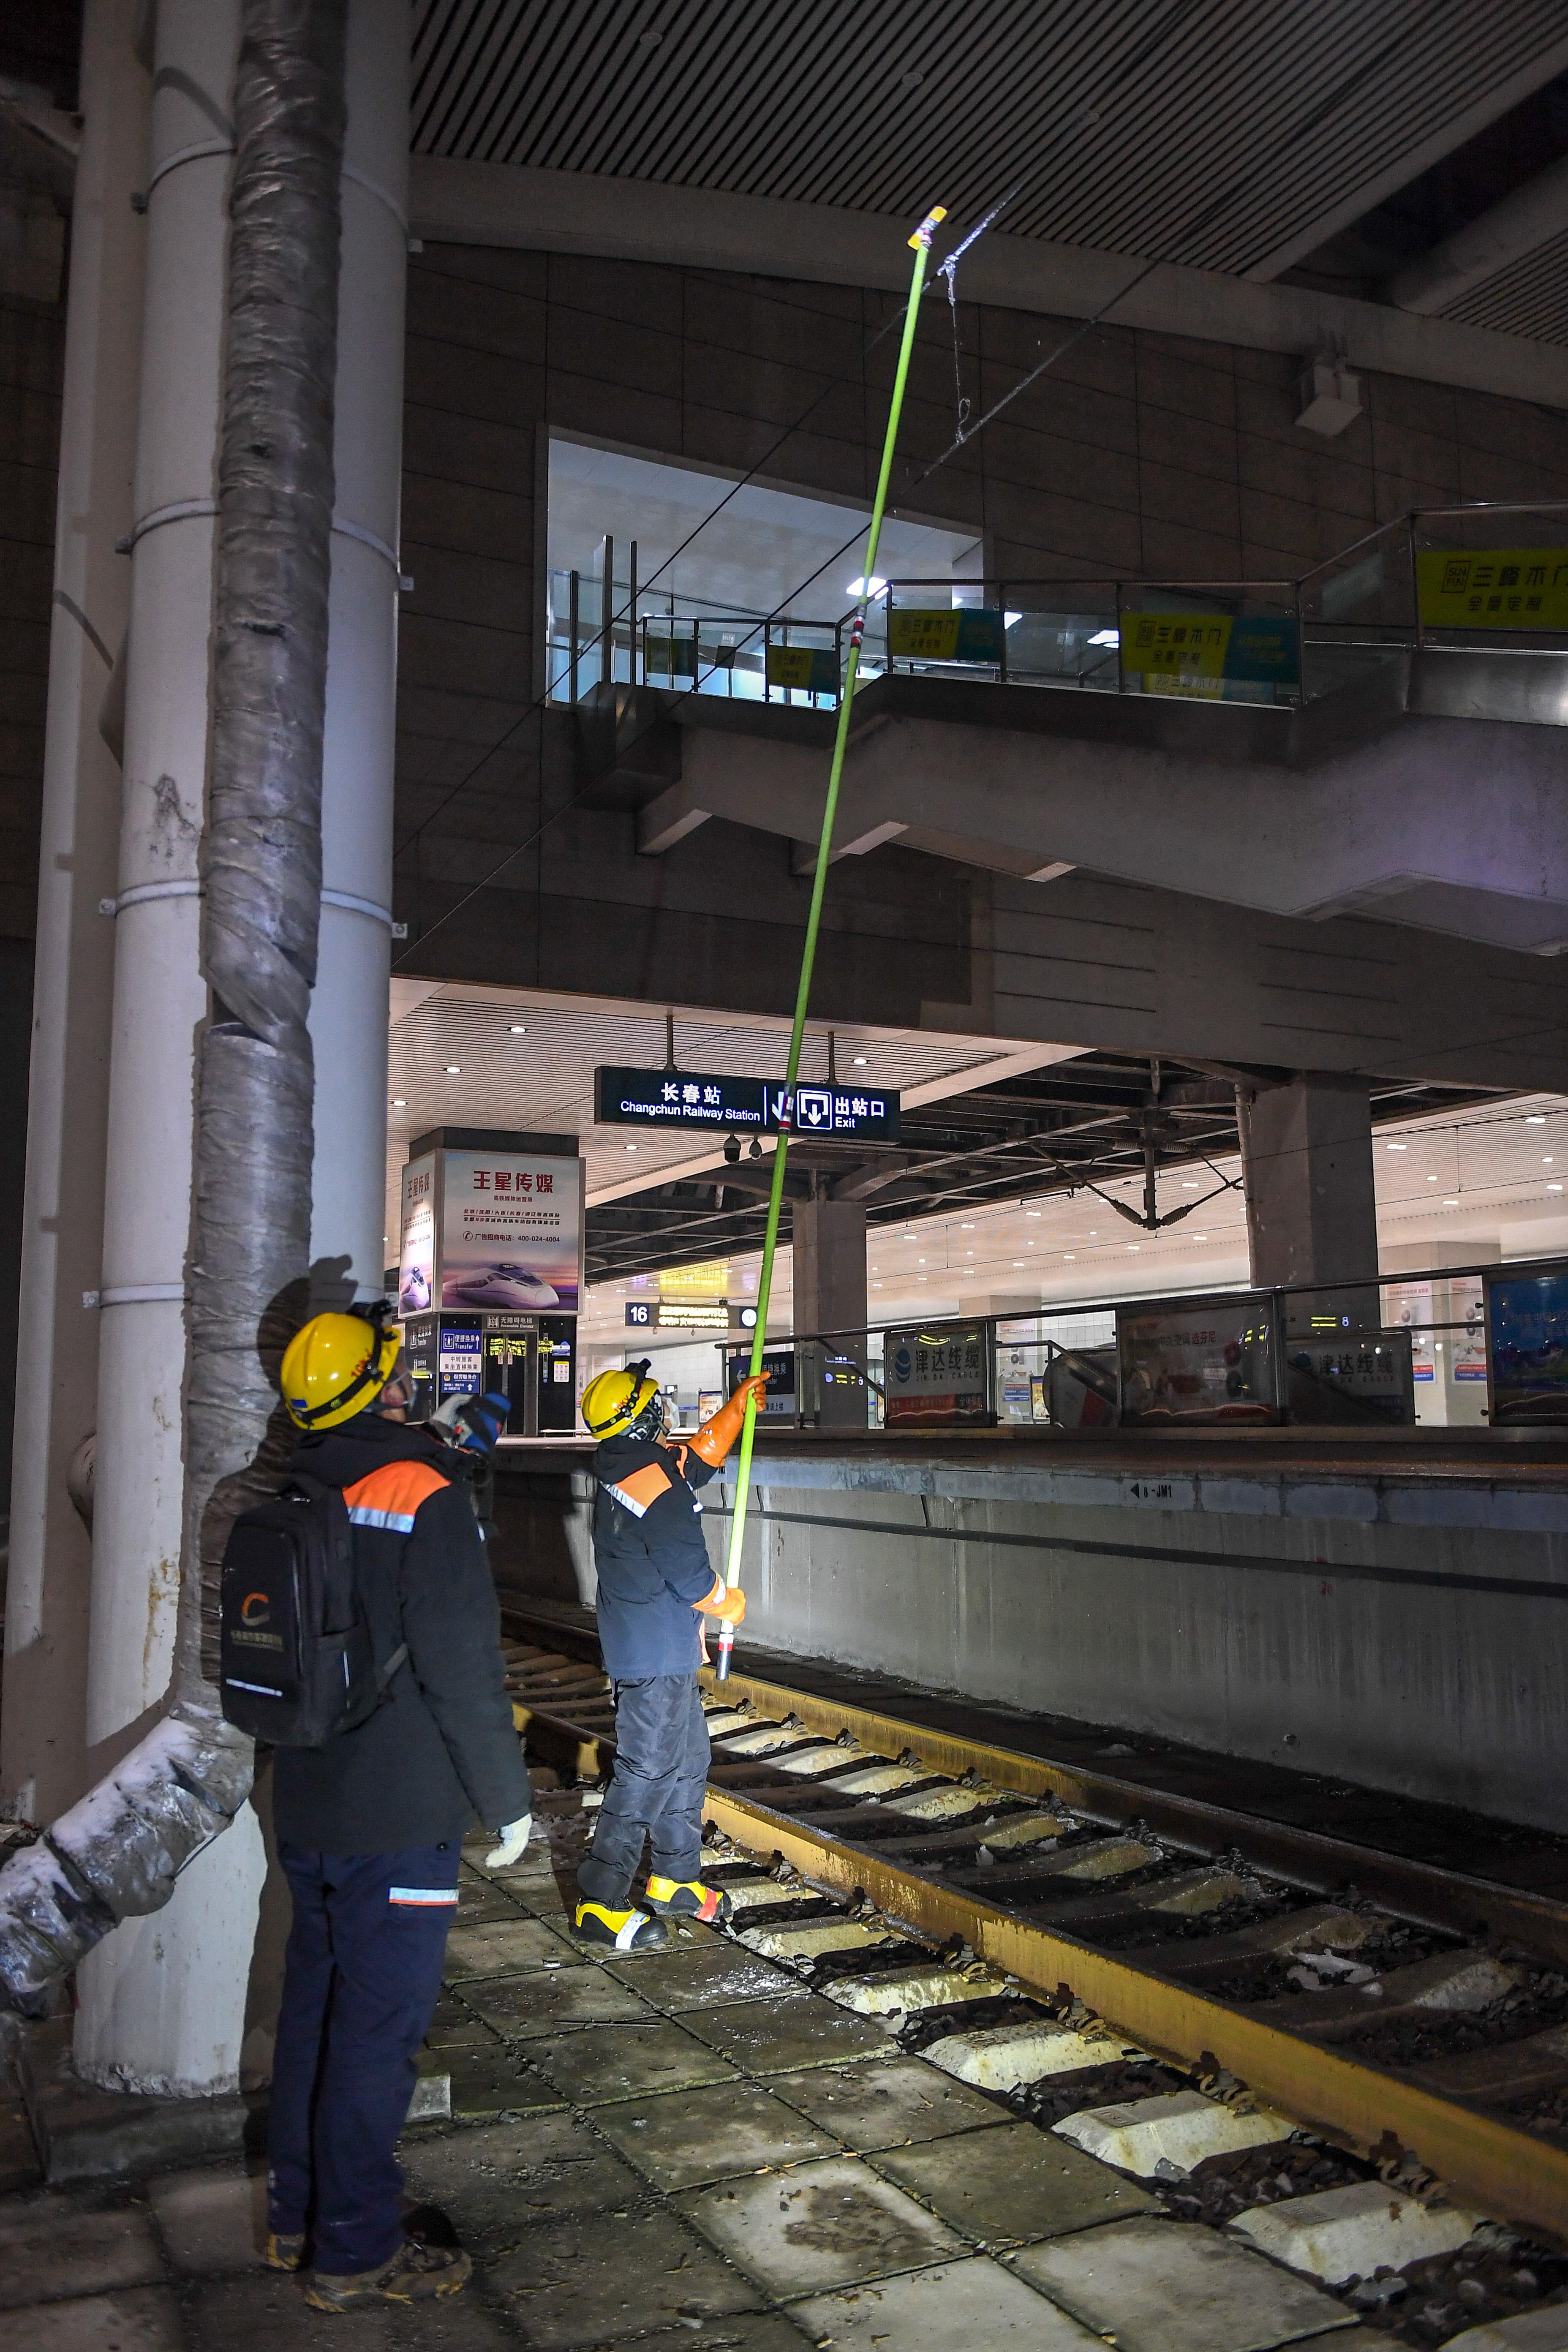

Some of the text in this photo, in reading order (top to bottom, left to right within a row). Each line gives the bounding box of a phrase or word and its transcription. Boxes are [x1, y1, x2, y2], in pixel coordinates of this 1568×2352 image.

[661, 1082, 721, 1105] 长春站
[621, 1100, 760, 1122] Changchun Railway Station
[835, 1097, 884, 1117] 出站口
[836, 1117, 855, 1128] Exit
[473, 1171, 553, 1194] 王星传媒
[630, 1306, 648, 1323] 16
[455, 1334, 476, 1342] 便捷换乘
[915, 1345, 980, 1373] 津达线缆
